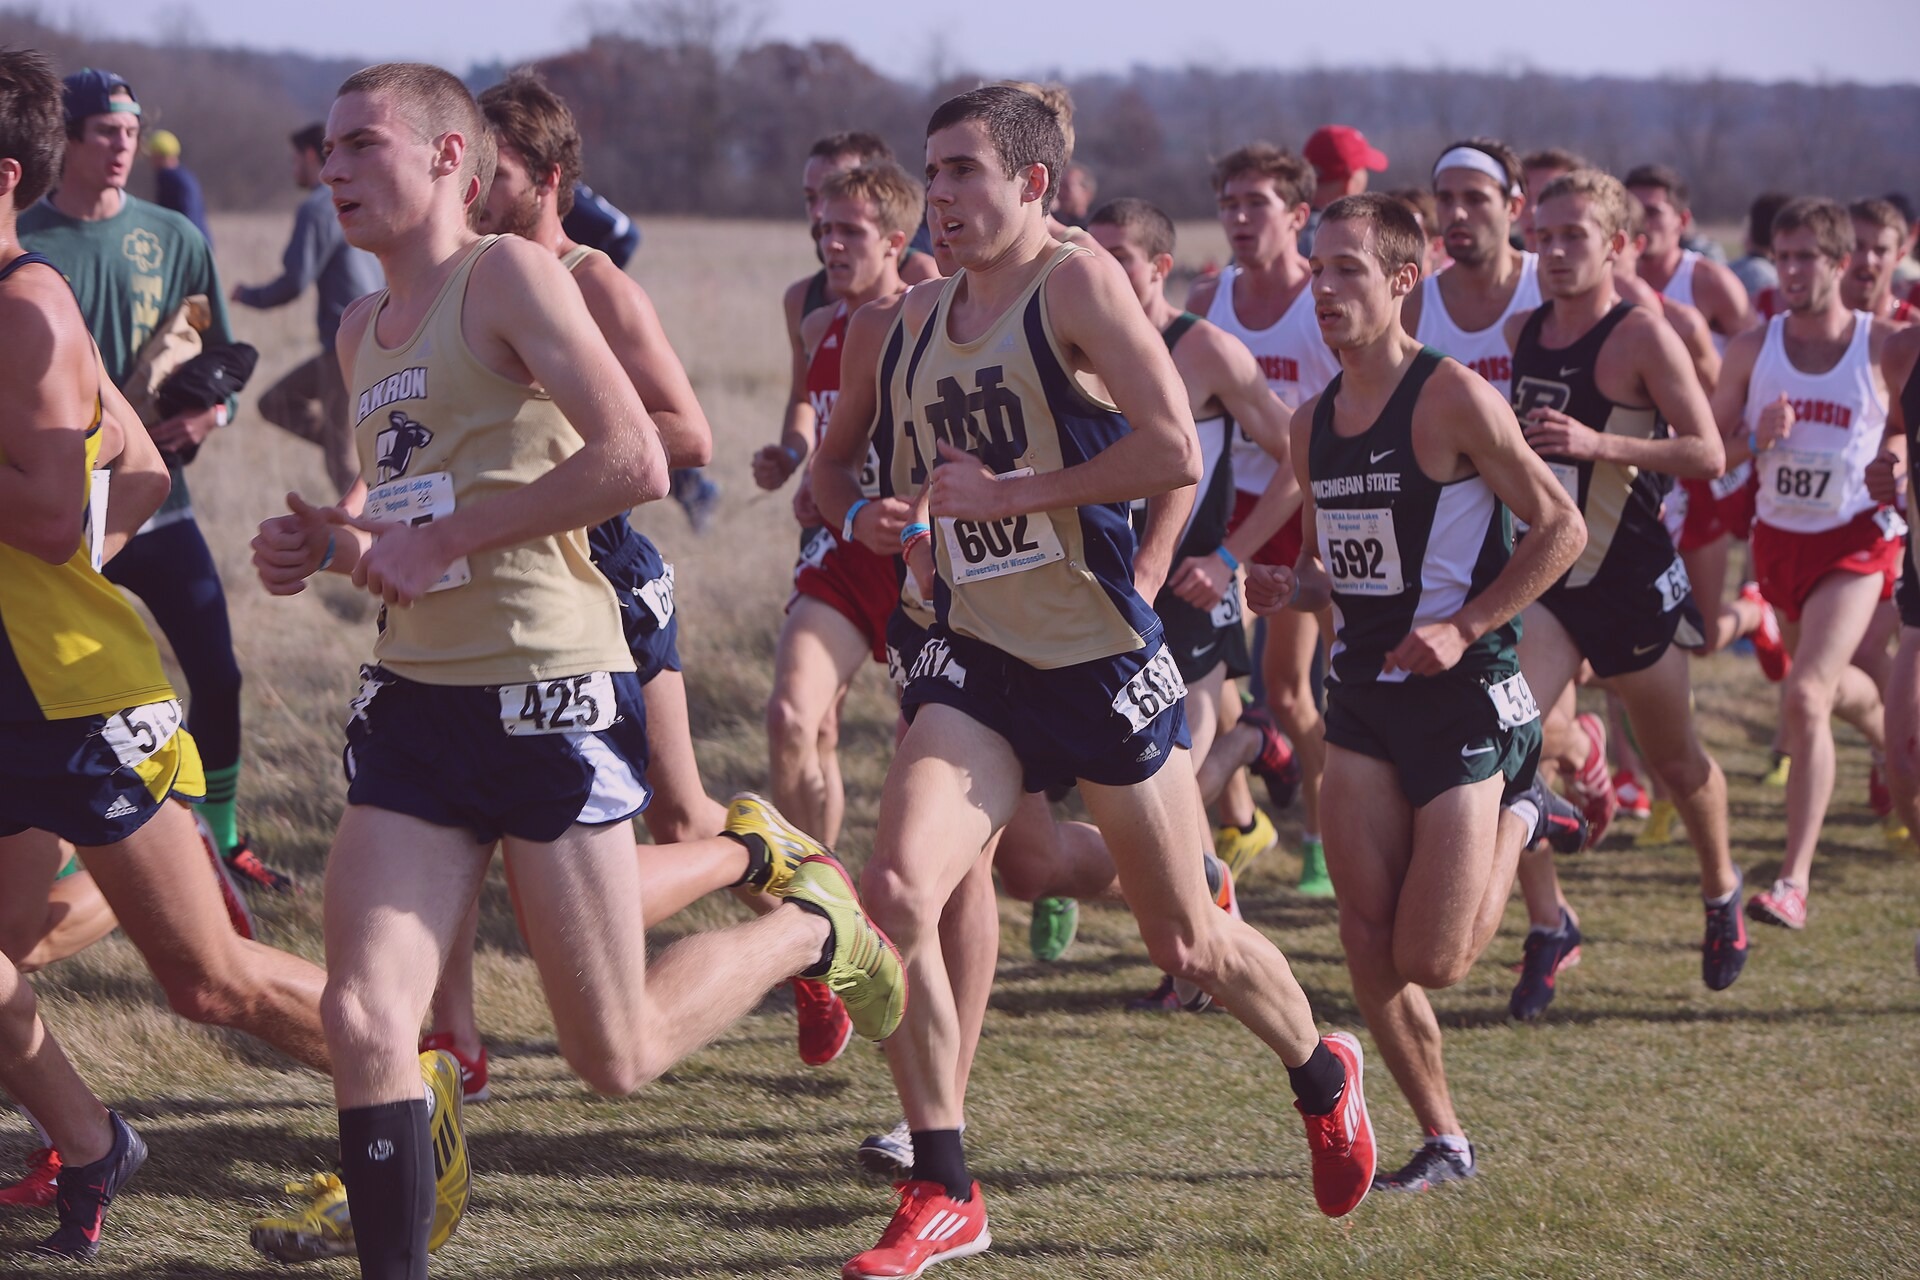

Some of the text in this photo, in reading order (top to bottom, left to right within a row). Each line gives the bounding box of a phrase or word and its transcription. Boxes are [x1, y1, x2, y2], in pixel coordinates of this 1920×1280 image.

[356, 367, 428, 428] AKRON
[1310, 472, 1401, 499] MICHIGAN STATE
[1776, 465, 1831, 499] 687
[954, 514, 1039, 564] 602
[965, 552, 1047, 577] University of Wisconsin
[1328, 538, 1386, 579] 592
[520, 676, 599, 730] 425
[1136, 749, 1161, 763] adidas
[104, 805, 139, 820] adidas
